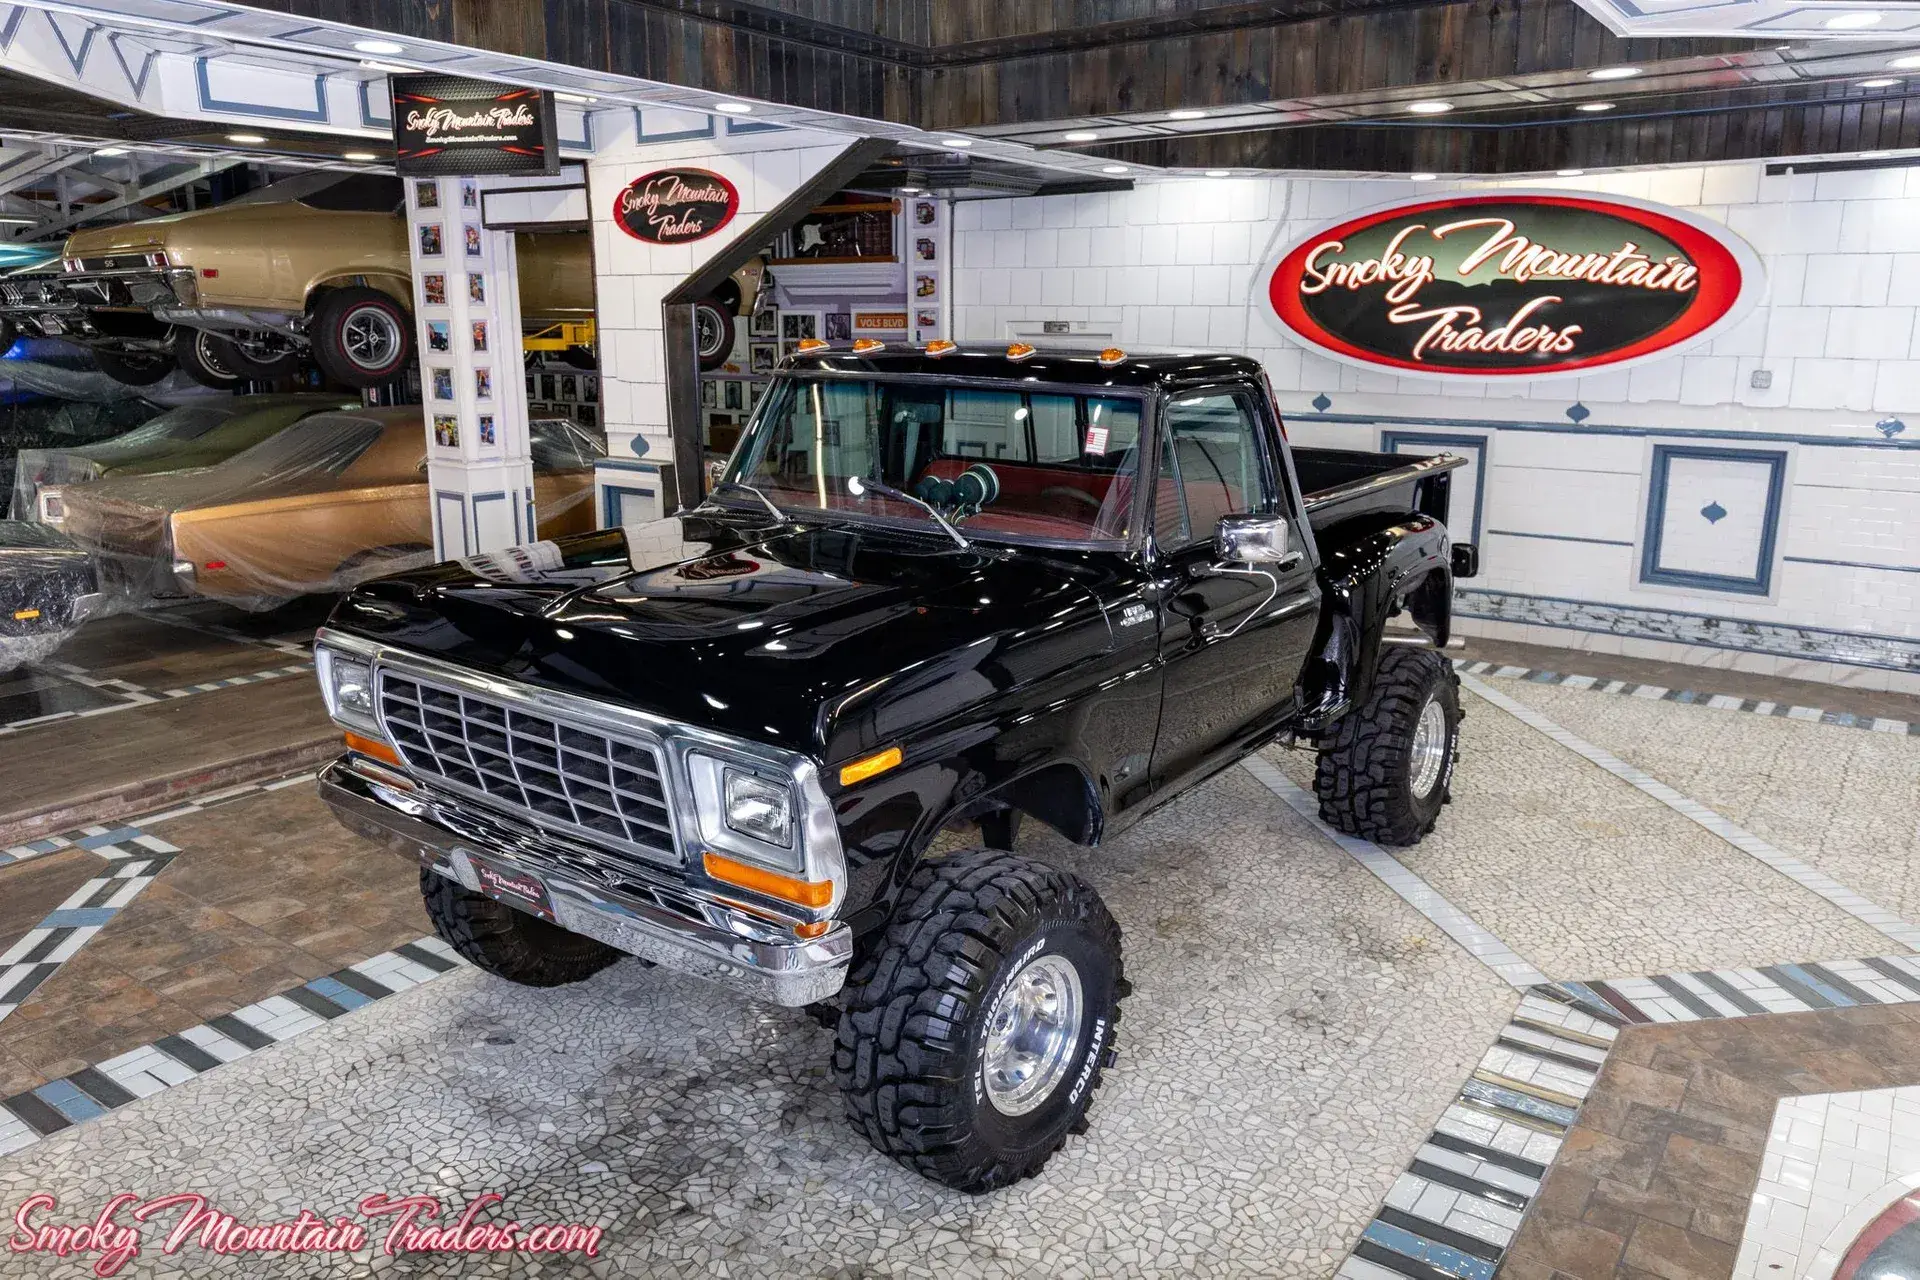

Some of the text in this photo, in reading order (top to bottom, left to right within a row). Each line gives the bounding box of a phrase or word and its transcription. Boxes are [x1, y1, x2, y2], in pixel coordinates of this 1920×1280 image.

[406, 103, 534, 137] Smoky Mountain Traders
[621, 175, 729, 216] Smoky Mountain
[648, 207, 703, 241] Traders
[1300, 216, 1700, 304] Smoky Mountain
[860, 318, 904, 328] VOLS BLVD
[1387, 295, 1583, 361] Traders
[980, 937, 1046, 1040] THORNBIRD
[1068, 1018, 1106, 1105] INTERCO
